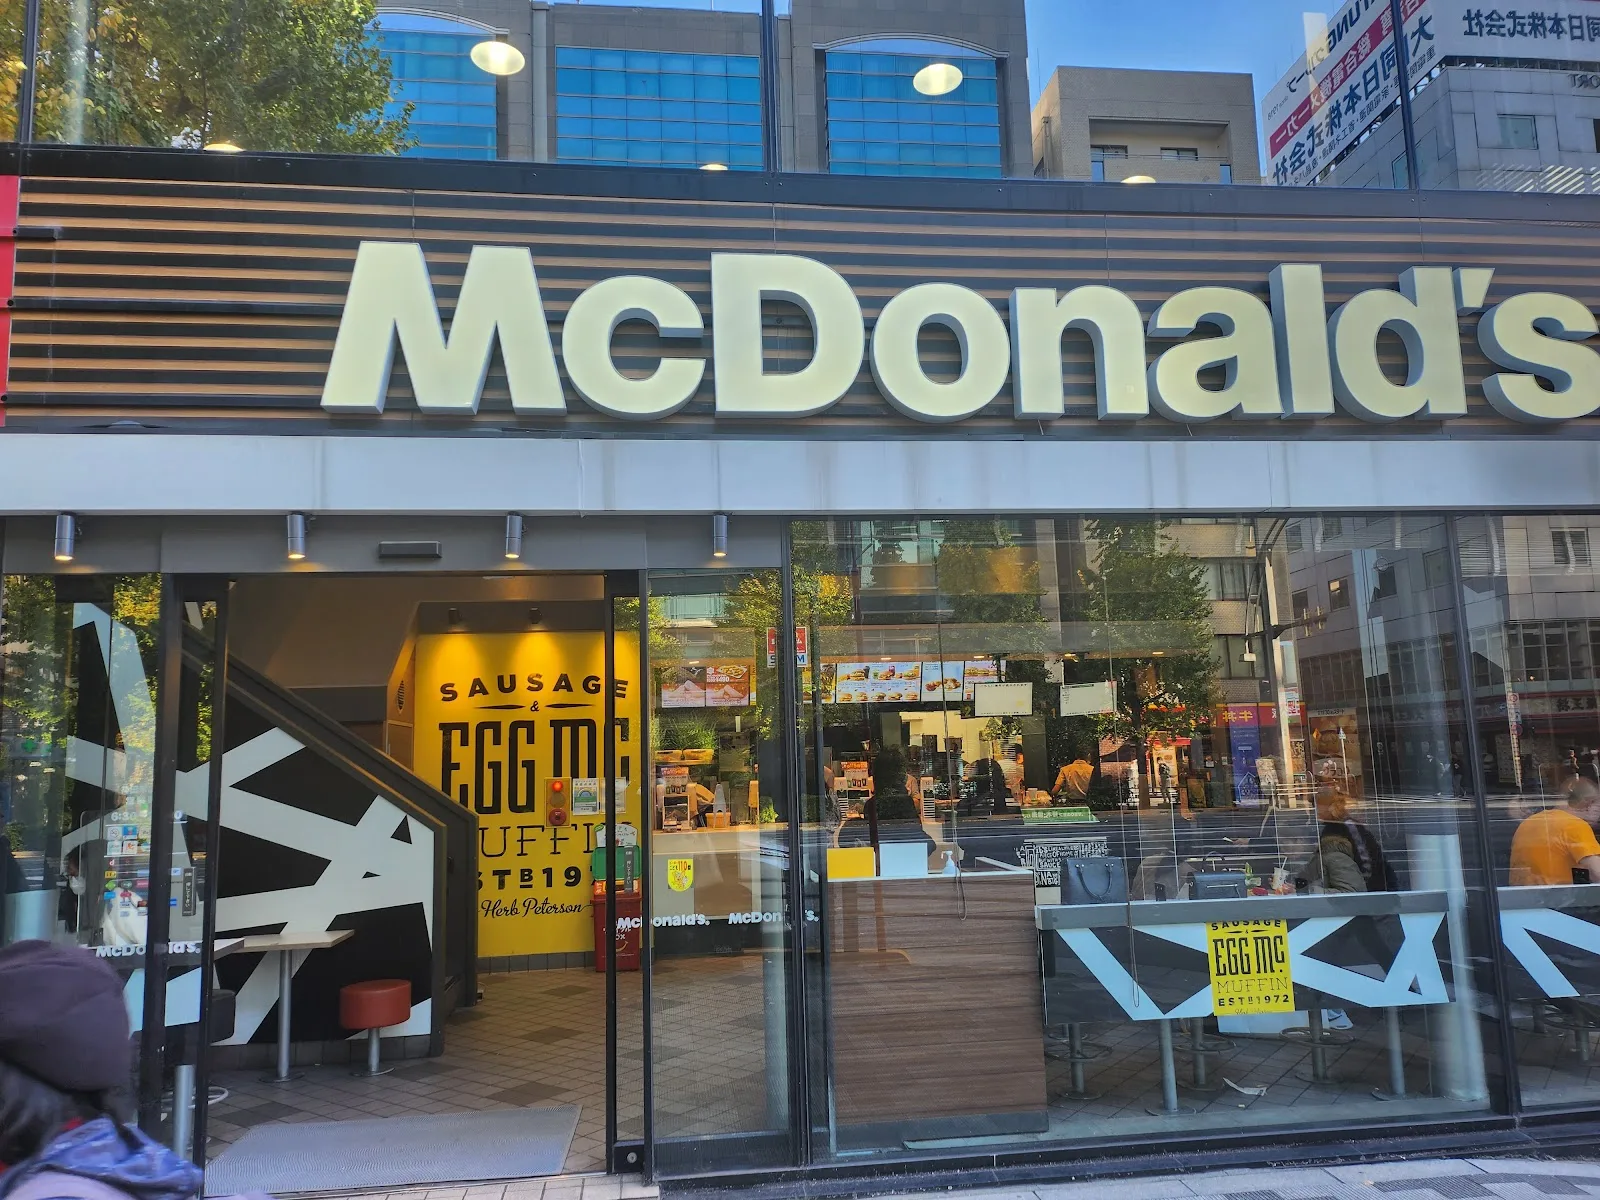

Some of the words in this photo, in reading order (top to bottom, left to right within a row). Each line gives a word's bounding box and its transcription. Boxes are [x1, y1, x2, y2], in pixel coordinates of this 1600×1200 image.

[320, 240, 1600, 423] McDonald's
[440, 673, 629, 701] SAUSAGE
[530, 700, 539, 712] &
[439, 719, 536, 814] EGG
[479, 821, 631, 857] UFFI
[481, 899, 520, 918] Herb
[522, 897, 583, 917] Peterson
[1211, 918, 1281, 931] SAUSAGE
[1213, 937, 1251, 976] EGG
[1217, 976, 1289, 994] MUFFIN
